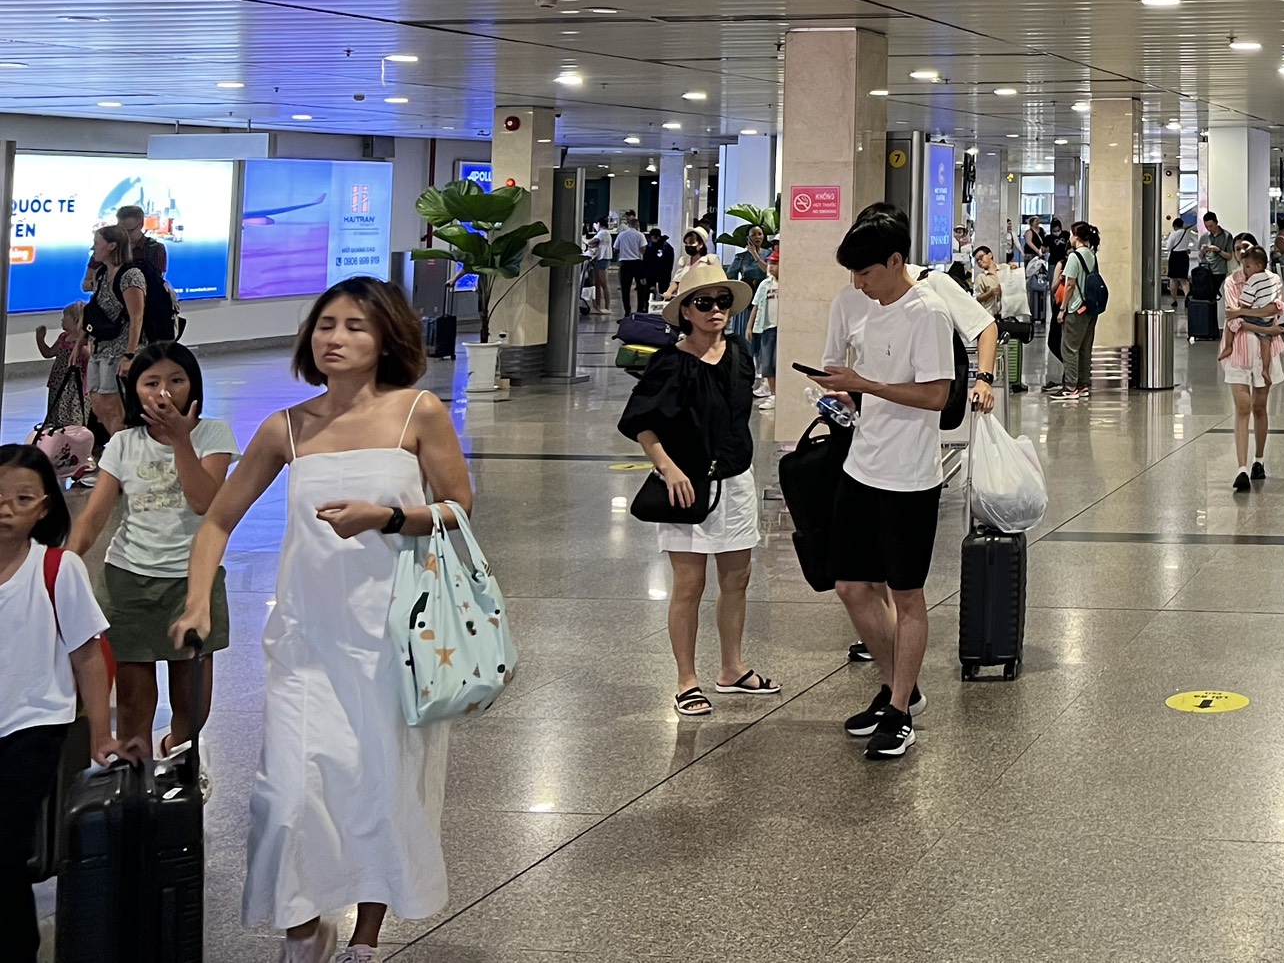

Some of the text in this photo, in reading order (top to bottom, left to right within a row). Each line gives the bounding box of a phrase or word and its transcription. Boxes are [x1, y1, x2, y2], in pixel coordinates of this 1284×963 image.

[894, 154, 900, 163] 7
[58, 193, 78, 213] TẾ
[10, 217, 36, 238] ẾN
